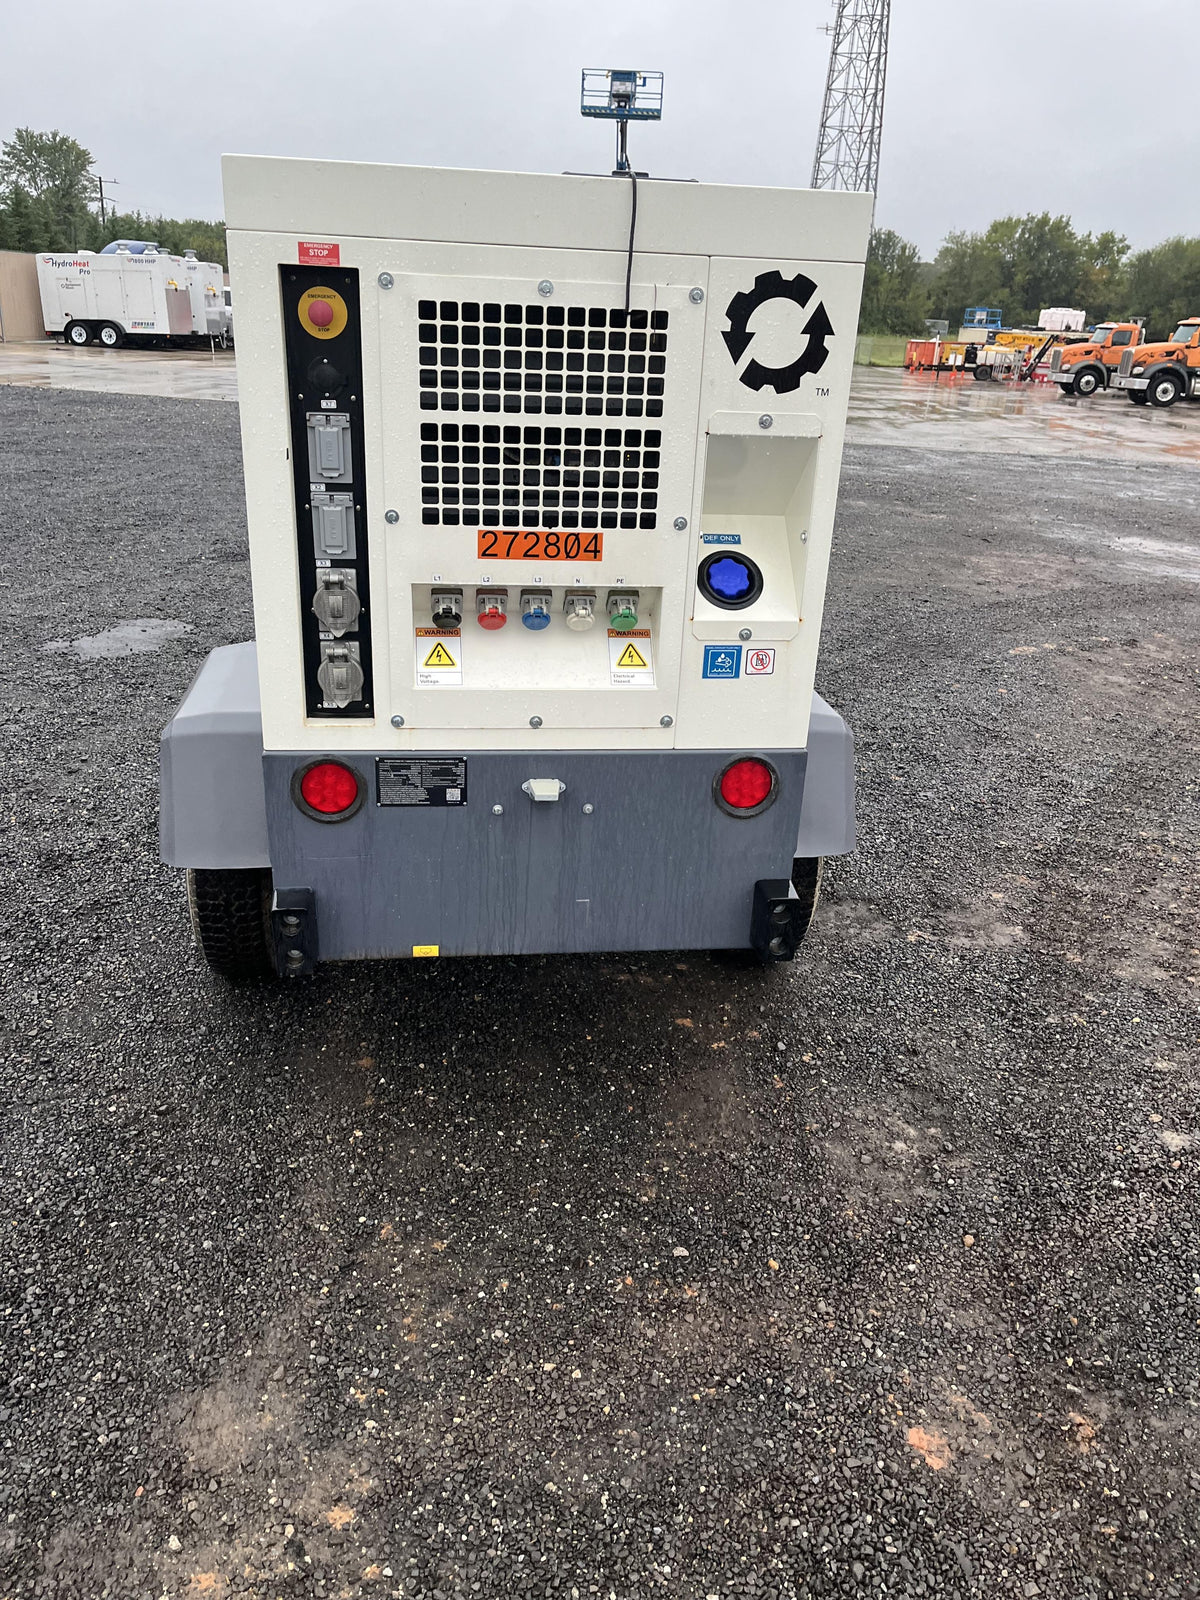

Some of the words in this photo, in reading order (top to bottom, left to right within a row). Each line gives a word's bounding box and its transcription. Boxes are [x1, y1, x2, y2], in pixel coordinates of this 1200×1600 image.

[308, 248, 329, 257] STOP
[51, 260, 90, 269] HydroHeat
[815, 387, 830, 396] TM
[480, 530, 601, 560] 272804
